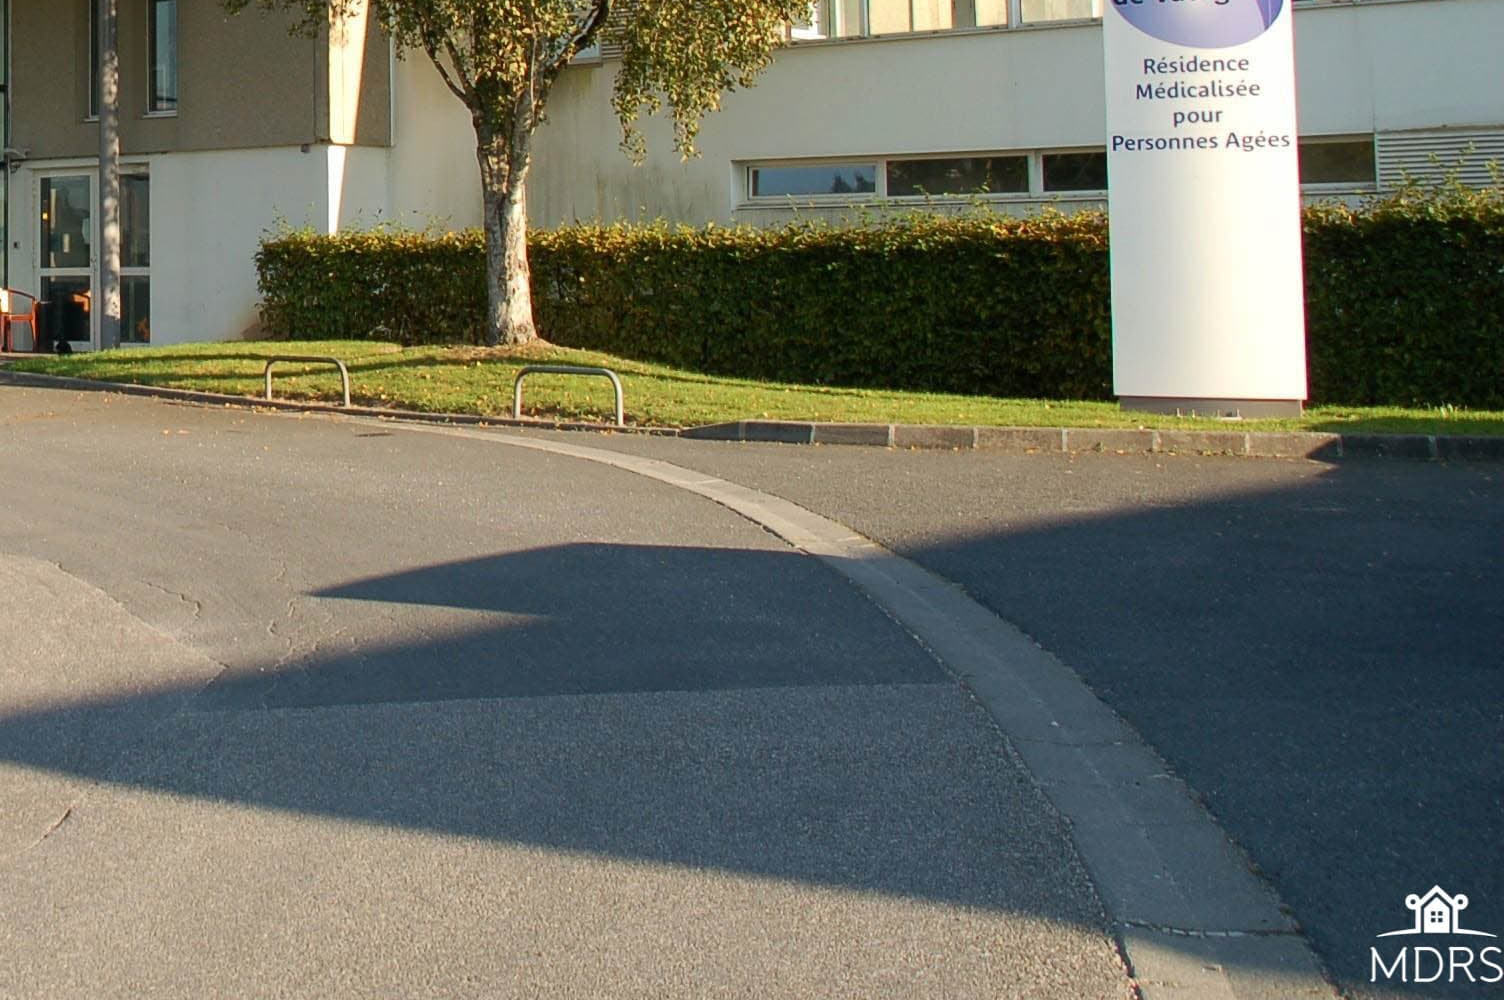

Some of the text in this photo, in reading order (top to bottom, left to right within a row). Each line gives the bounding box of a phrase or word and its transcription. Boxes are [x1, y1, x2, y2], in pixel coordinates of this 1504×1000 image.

[1144, 55, 1249, 74] Résidence
[1136, 80, 1261, 100] Médicalisée
[1173, 110, 1223, 127] pour
[1112, 130, 1290, 152] Personnes Agées
